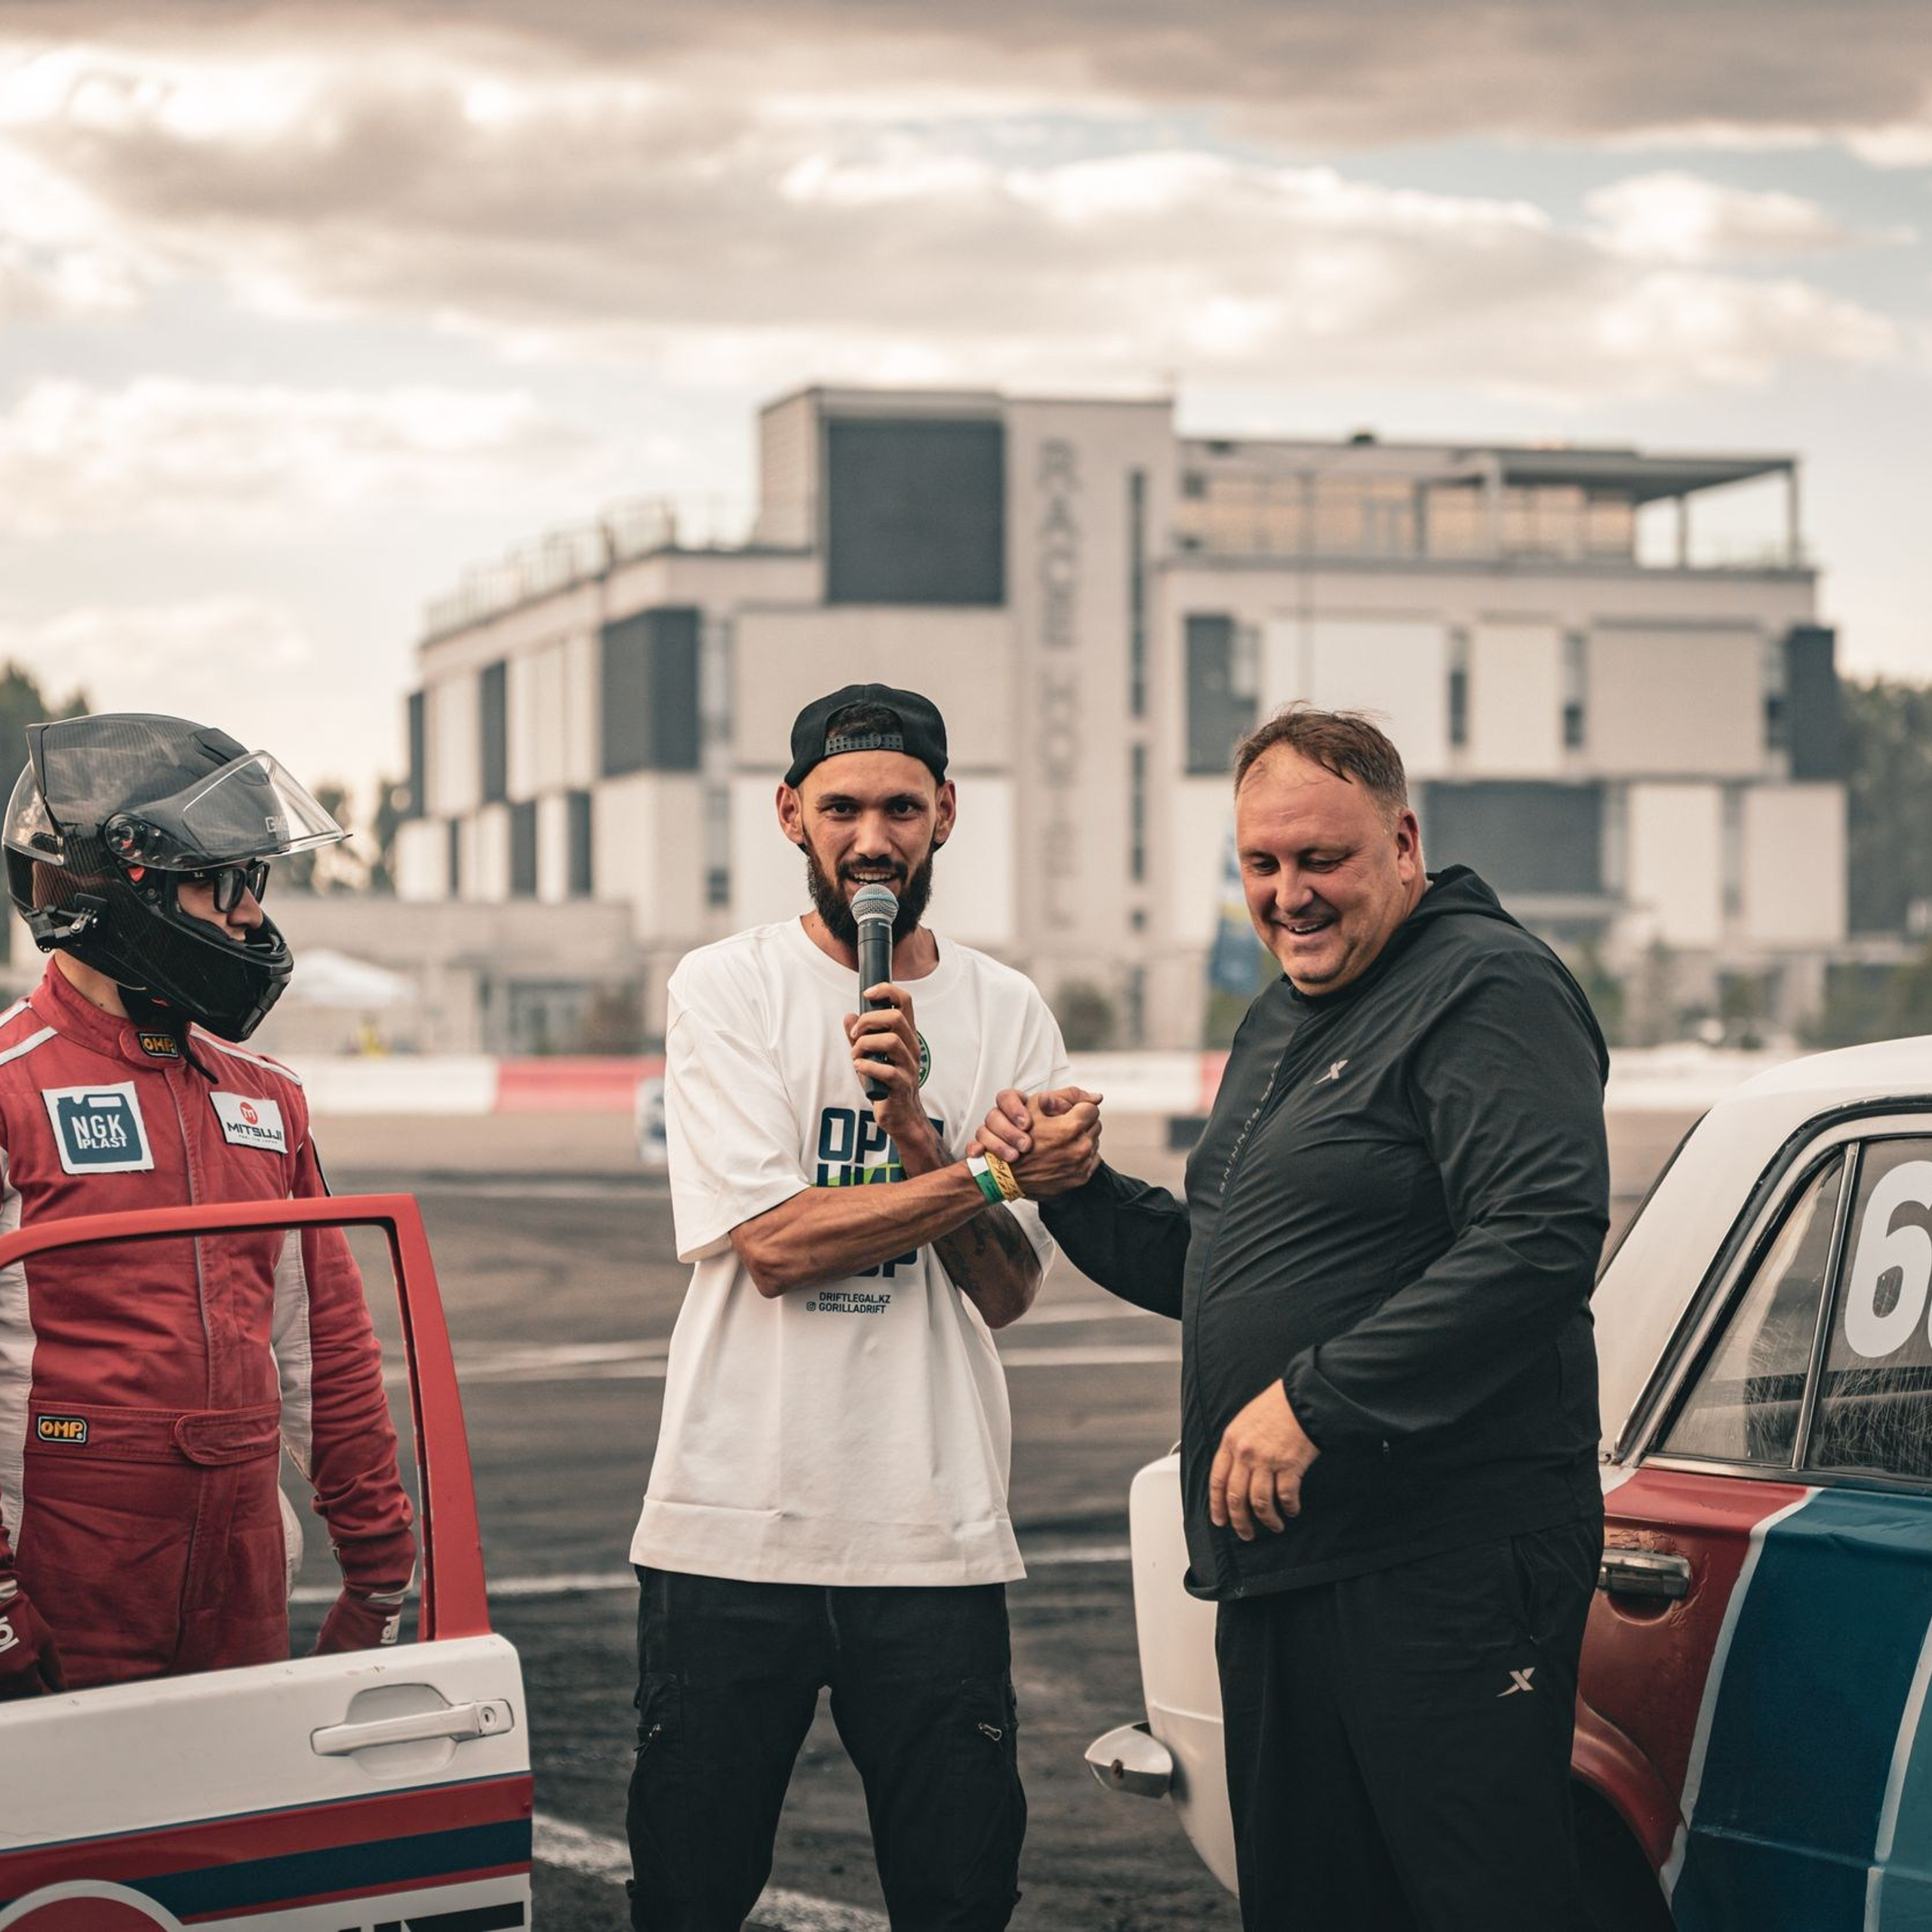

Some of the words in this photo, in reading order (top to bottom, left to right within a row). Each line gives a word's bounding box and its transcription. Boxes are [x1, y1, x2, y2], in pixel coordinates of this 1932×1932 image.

[144, 1038, 174, 1052] OMP
[71, 1114, 127, 1140] NGK
[226, 1121, 283, 1141] MITSUJI
[79, 1136, 128, 1149] PLAST
[1844, 1160, 1932, 1358] 6
[819, 1291, 891, 1304] DRIFTLEGAL.KZ
[818, 1303, 887, 1314] GORILLADRIFT
[41, 1420, 84, 1438] OMP
